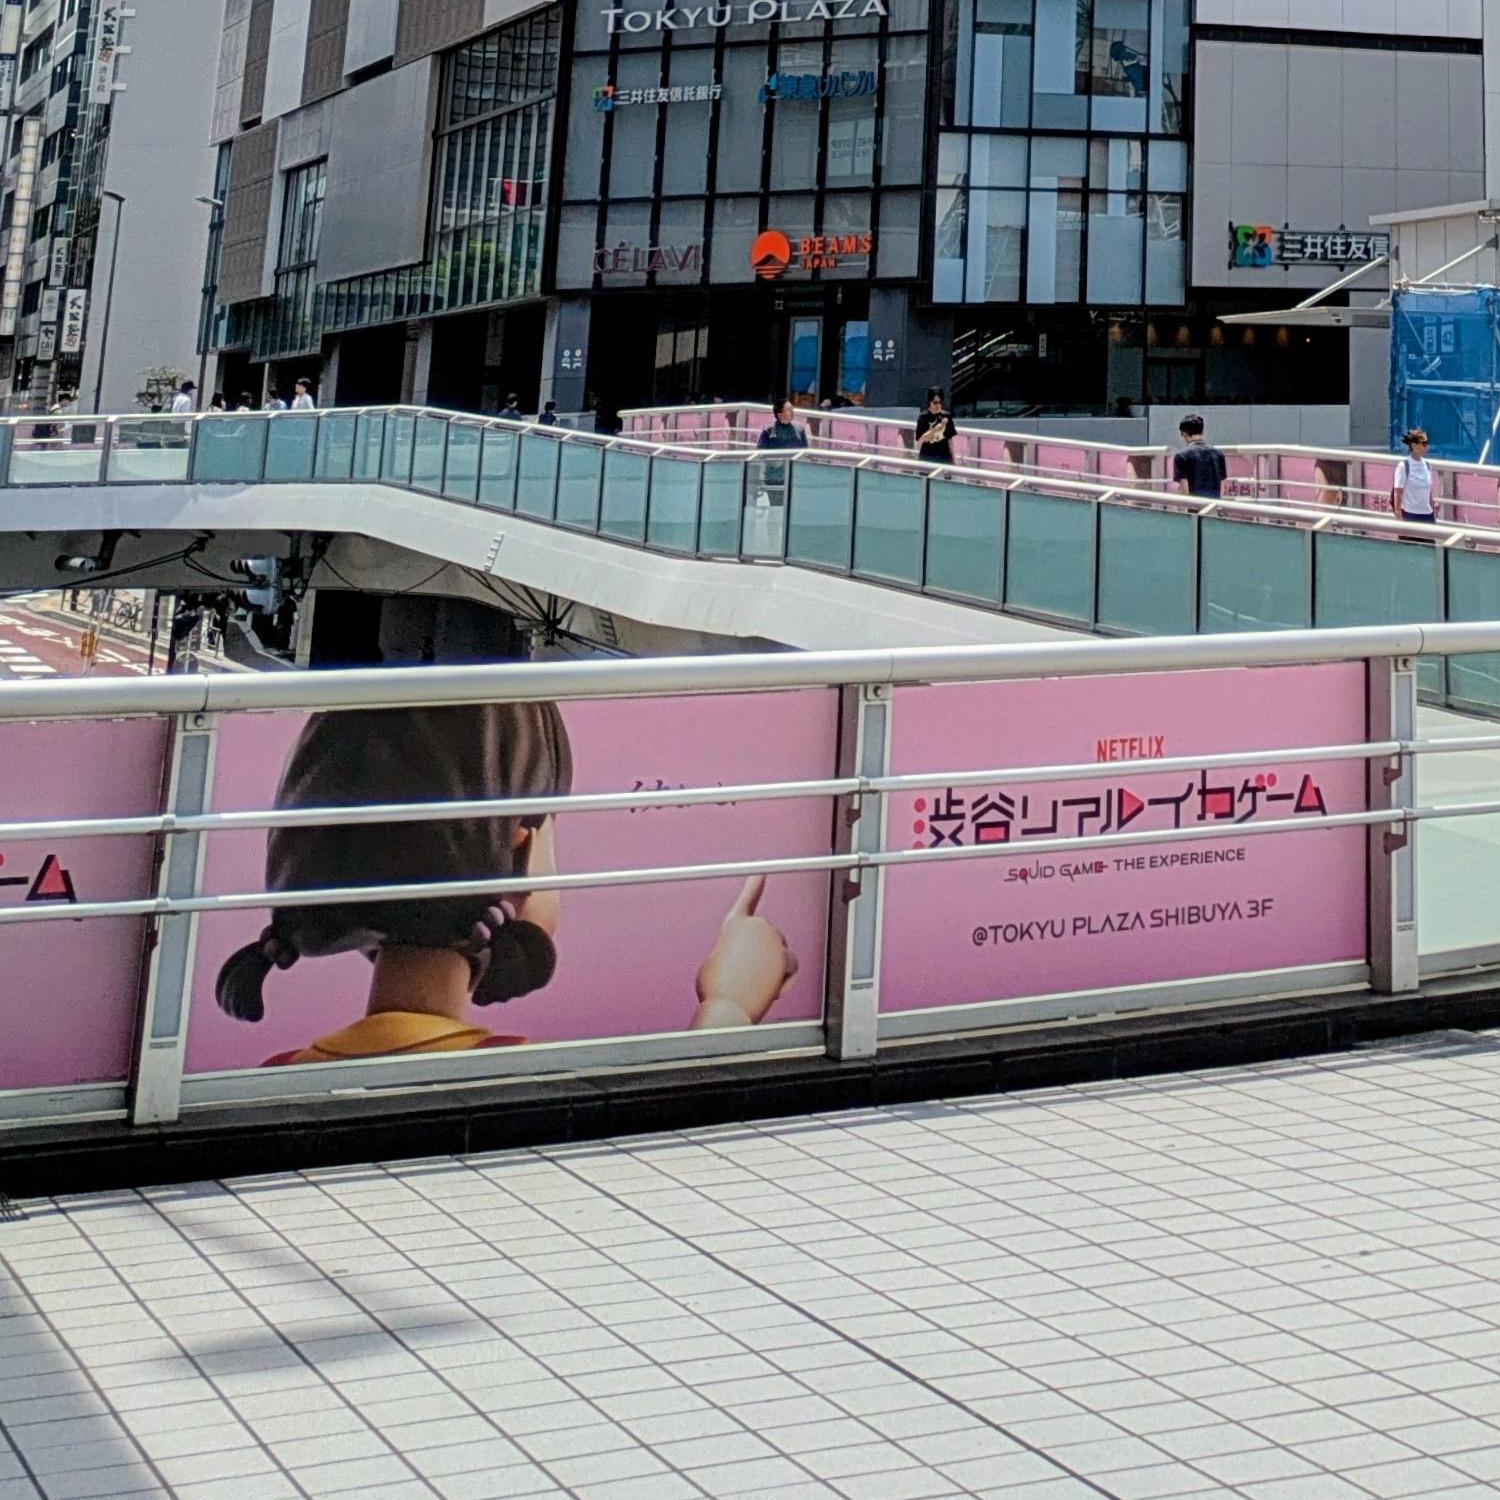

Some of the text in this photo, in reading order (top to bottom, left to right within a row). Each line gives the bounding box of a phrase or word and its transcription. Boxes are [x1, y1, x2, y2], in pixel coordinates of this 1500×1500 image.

[601, 5, 732, 34] TOKYU
[615, 84, 722, 105] 三井住友信託銀行
[801, 234, 873, 255] BEAMS
[1283, 235, 1390, 260] 三井住友信
[801, 258, 837, 270] JAPAN
[1096, 735, 1166, 762] NETFLIX
[1003, 847, 1246, 883] SQUID GAME THE EXPERIENCE
[972, 898, 1275, 946] @TOKYU PLAZA SHIBUYA 3F
